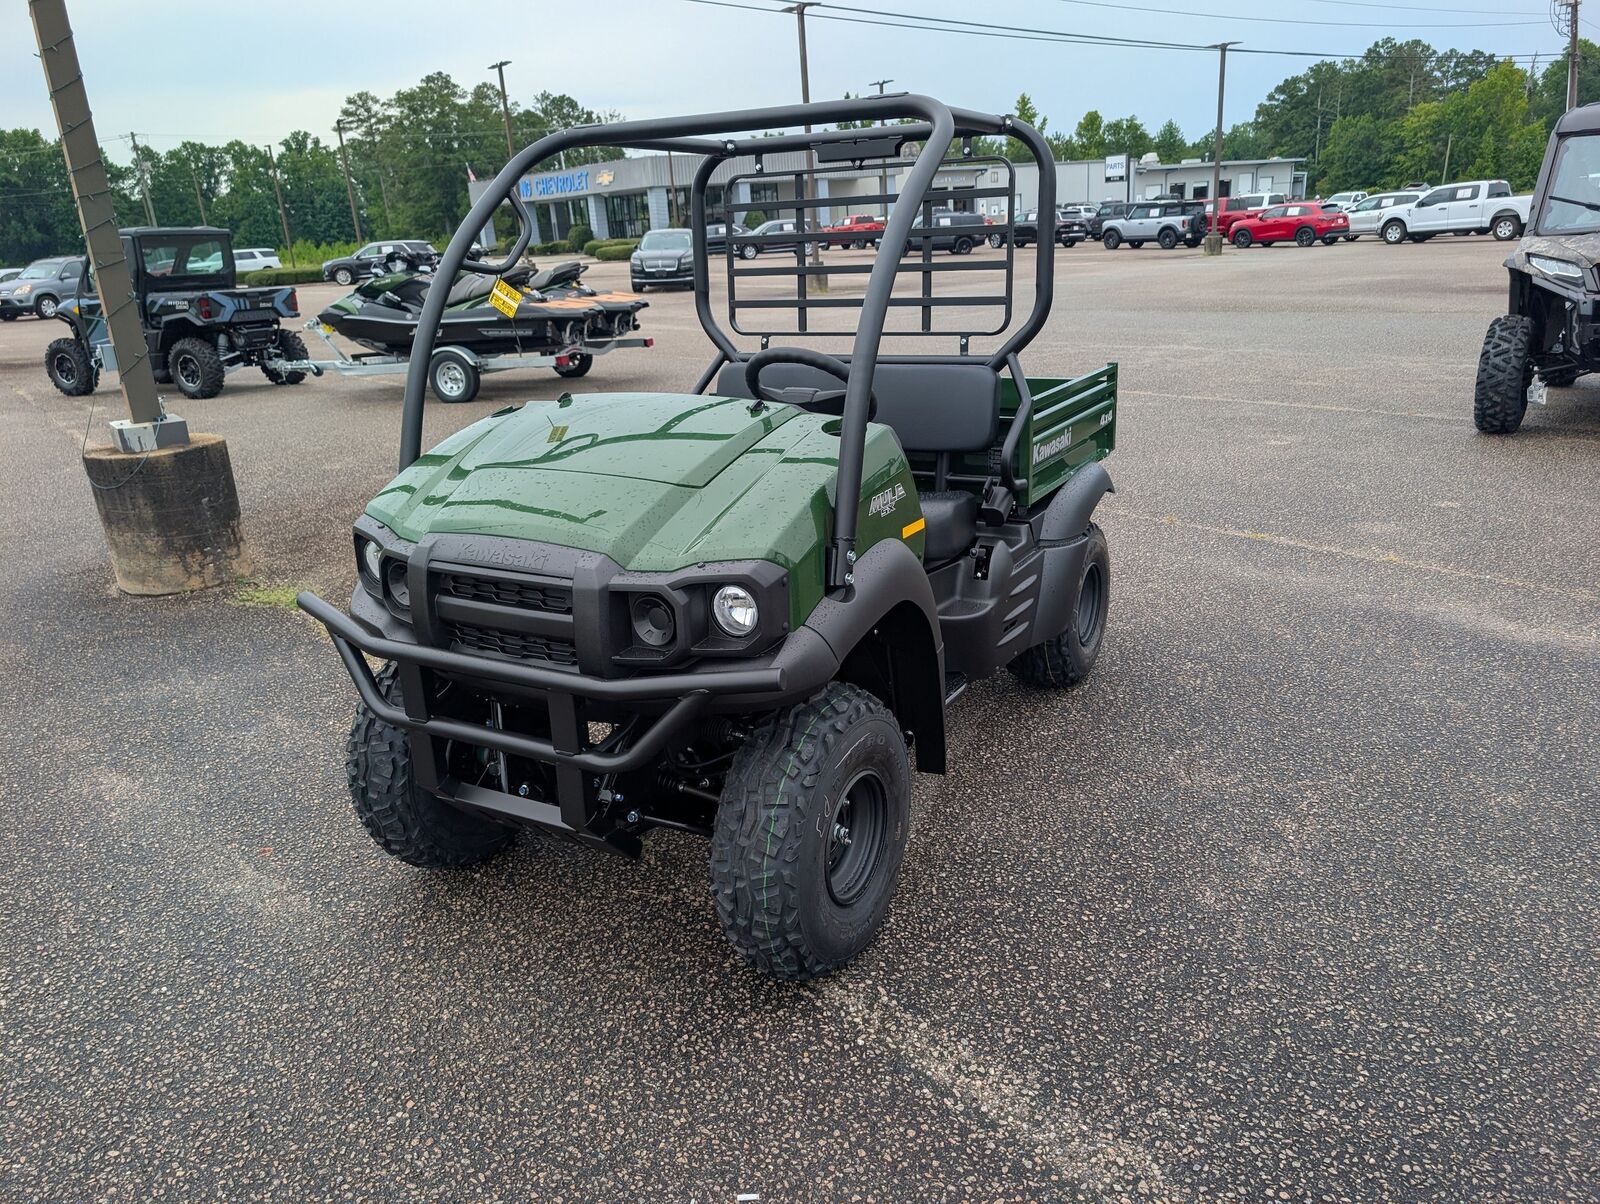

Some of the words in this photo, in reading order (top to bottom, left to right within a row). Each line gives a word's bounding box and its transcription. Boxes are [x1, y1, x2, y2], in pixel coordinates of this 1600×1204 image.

[1106, 161, 1125, 170] PARTS
[535, 169, 589, 196] CHEVROLET
[1100, 409, 1113, 427] 4x4
[1032, 426, 1072, 465] Kawasaki
[868, 482, 907, 516] MULE
[880, 501, 896, 518] SX
[454, 541, 551, 571] Kawasaki
